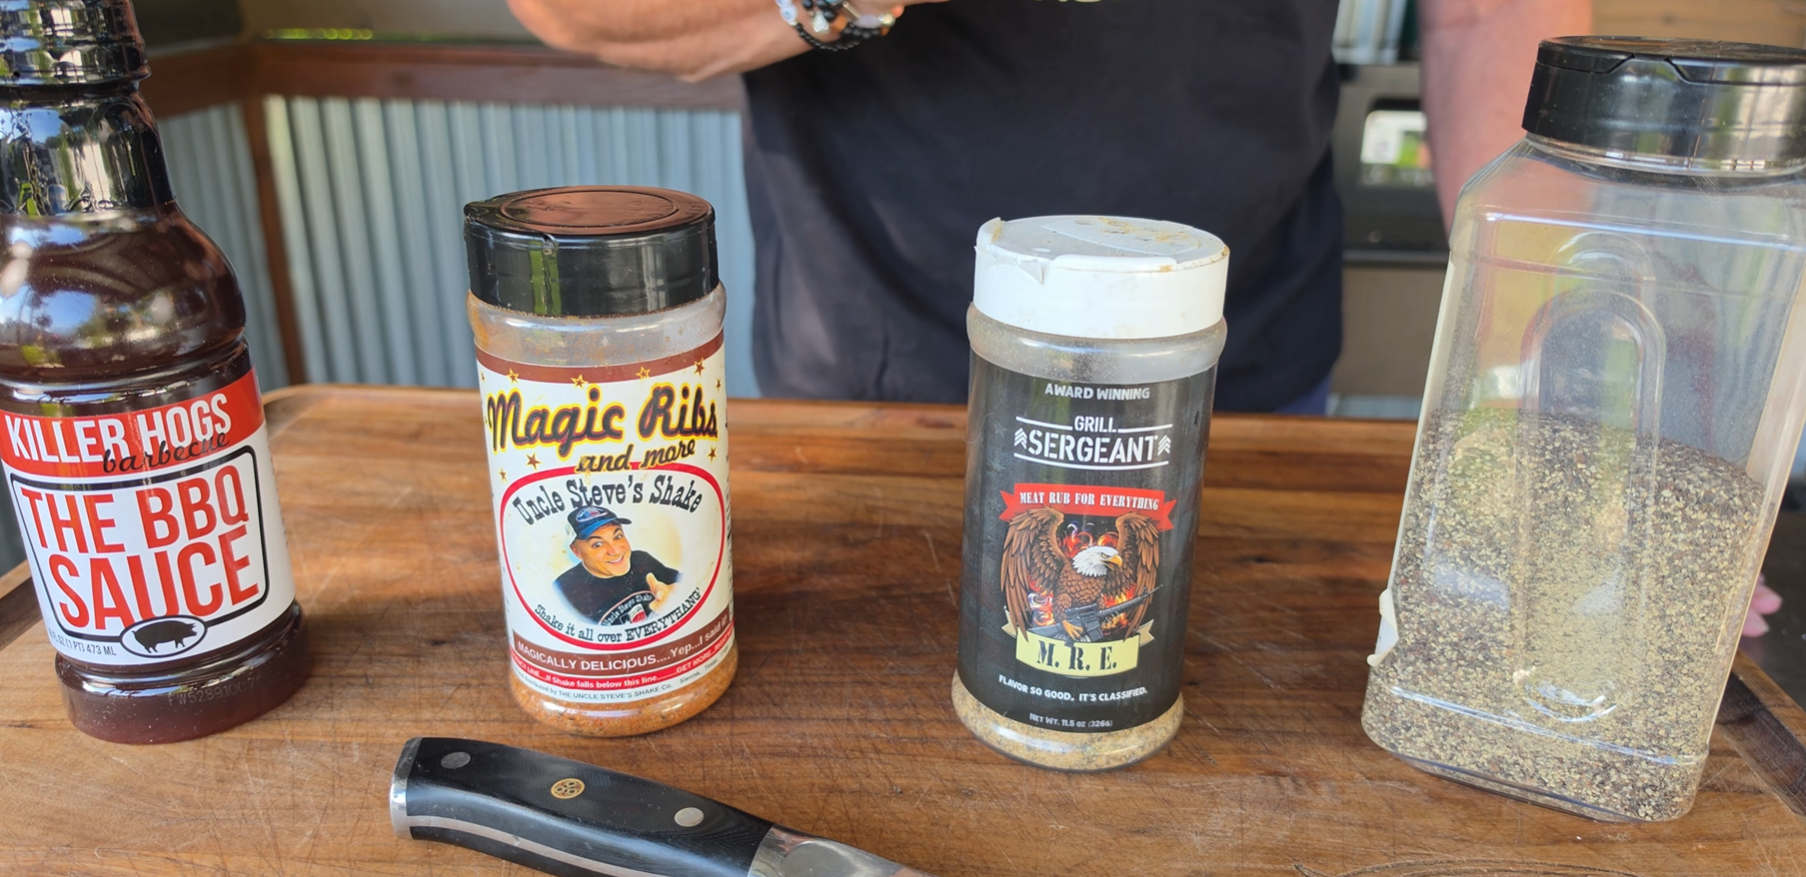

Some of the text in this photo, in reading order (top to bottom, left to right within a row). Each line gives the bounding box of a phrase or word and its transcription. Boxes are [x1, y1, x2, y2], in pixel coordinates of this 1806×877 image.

[1044, 383, 1150, 400] AWARD WINNING
[5, 393, 232, 464] KILLER HOGS
[487, 383, 719, 458] Magic Ribs
[1074, 415, 1117, 433] GRILL
[103, 432, 230, 473] barbecue
[576, 438, 696, 473] and more
[1028, 429, 1158, 464] SERGEANT
[21, 465, 250, 554] THE BBQ
[512, 474, 703, 525] Uncle Steve's Shake
[1019, 491, 1160, 511] MEAT RUB FOR EVERYTHING
[49, 525, 259, 630] SAUCE
[534, 604, 564, 631] Shake
[565, 622, 577, 636] it
[578, 627, 594, 641] all
[597, 632, 623, 643] over
[86, 643, 102, 655] 473
[103, 645, 117, 656] ML
[518, 641, 577, 669] MAGICALLY
[704, 621, 721, 641] said
[1036, 640, 1117, 671] M. R. E.
[552, 676, 575, 688] Shake
[577, 680, 594, 688] falls
[596, 679, 622, 688] below
[623, 677, 641, 687] this
[559, 690, 571, 698] THE
[600, 690, 632, 699] STEVE'S
[634, 686, 660, 698] SHAKE
[998, 674, 1149, 702] FLAVOR SO GOOD. IT'S CLASSIFIED.
[1061, 718, 1076, 727] 11.5
